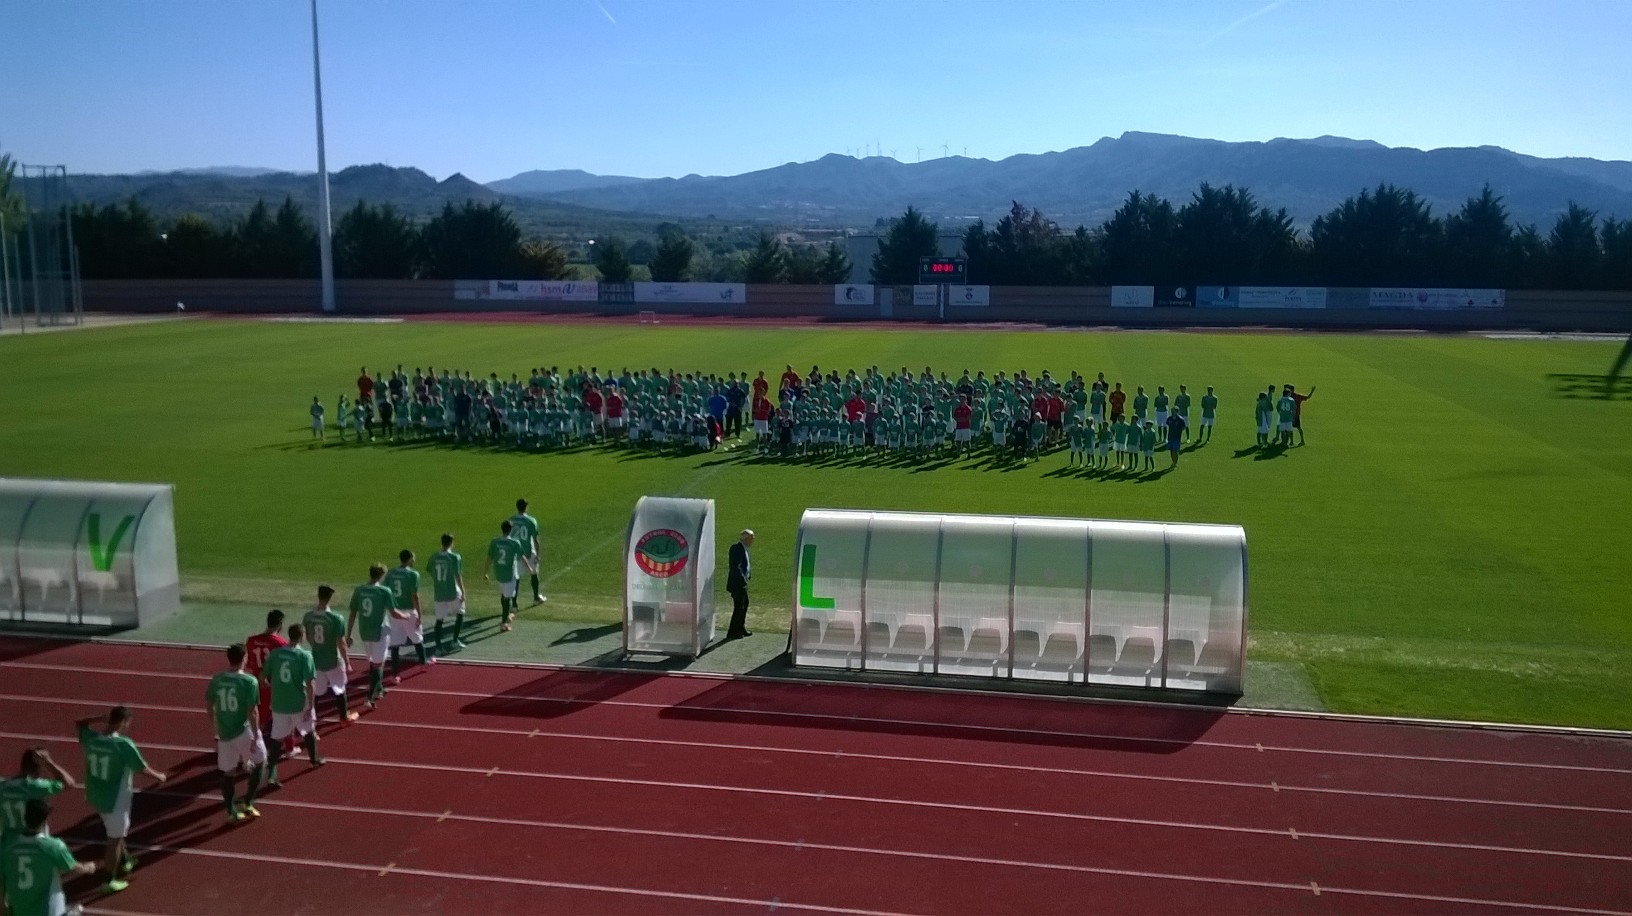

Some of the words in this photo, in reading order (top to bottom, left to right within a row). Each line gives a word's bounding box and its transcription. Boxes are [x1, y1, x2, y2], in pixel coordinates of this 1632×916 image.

[88, 513, 136, 572] V
[498, 549, 507, 565] 2
[435, 564, 448, 581] 17
[800, 544, 835, 609] L
[394, 579, 402, 597] 3
[362, 598, 373, 617] 9
[314, 625, 325, 644] 8
[280, 661, 292, 683] 6
[216, 687, 239, 712] 16
[87, 754, 109, 781] 11
[17, 855, 34, 890] 5
